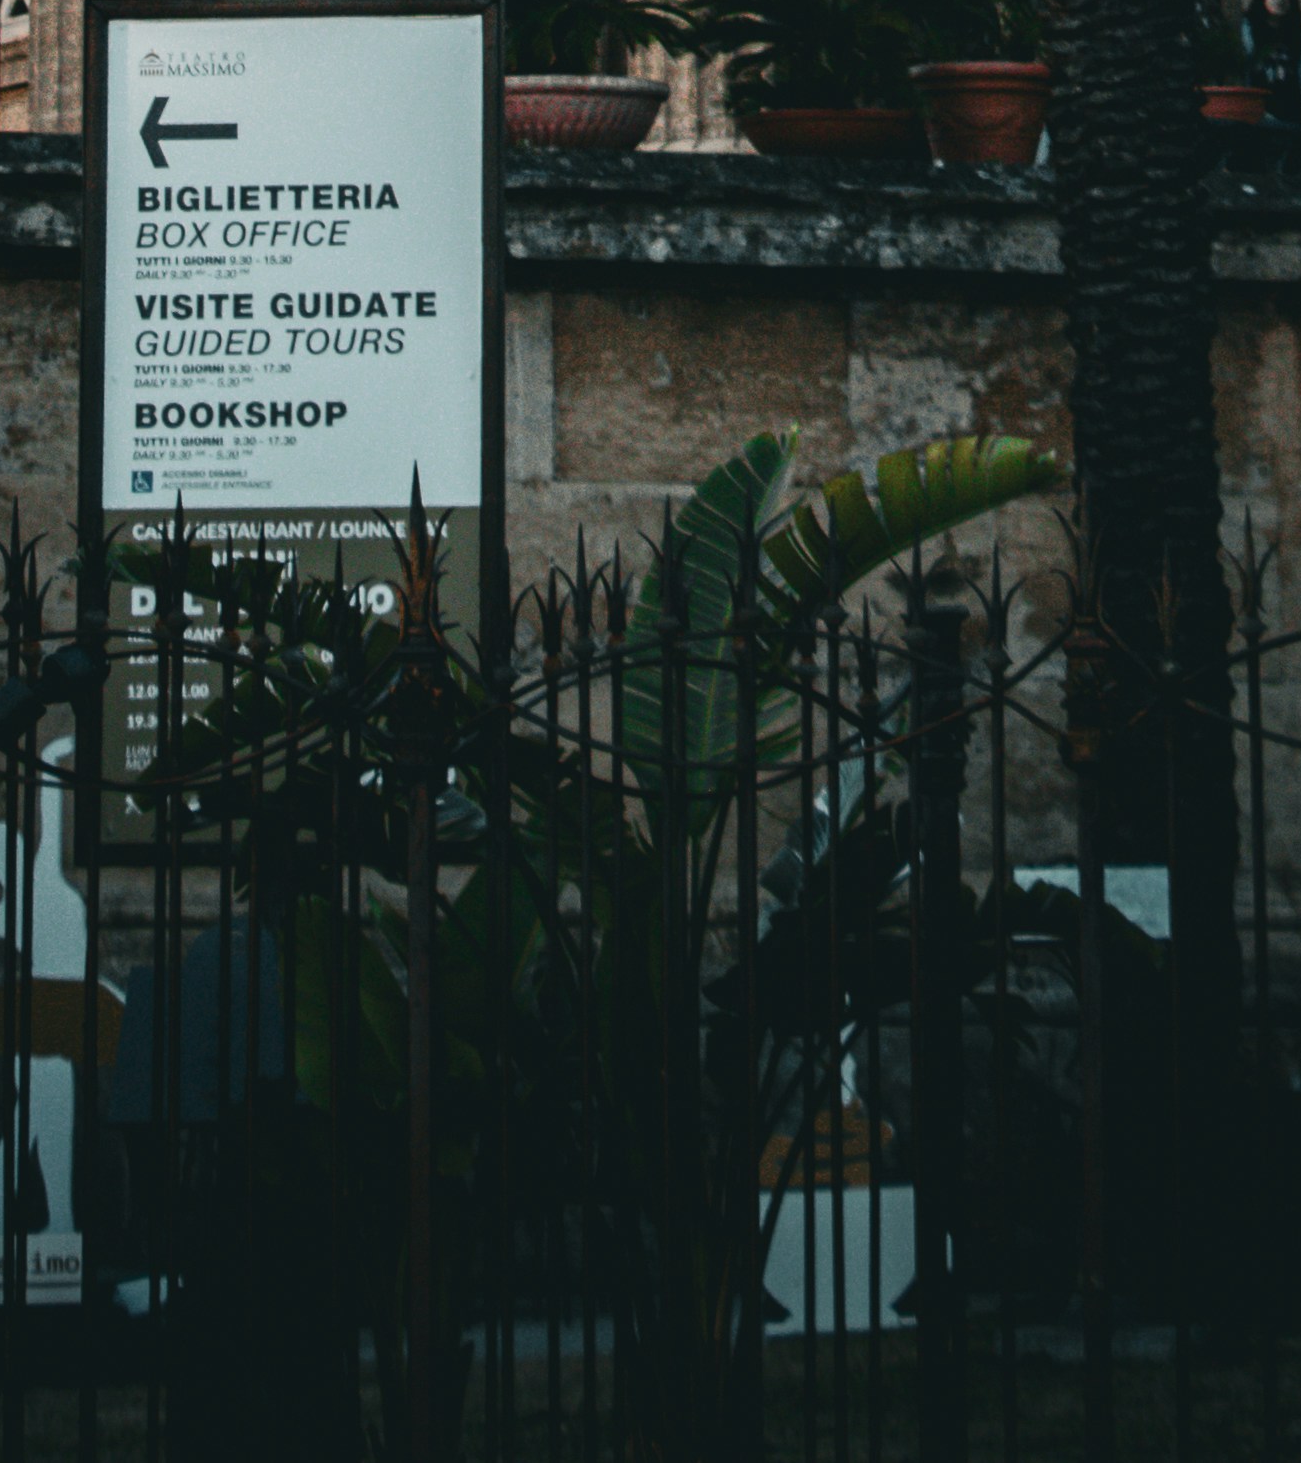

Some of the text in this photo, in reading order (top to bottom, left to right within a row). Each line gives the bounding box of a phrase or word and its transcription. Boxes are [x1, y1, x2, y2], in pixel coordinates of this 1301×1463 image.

[167, 51, 245, 62] TEATRO
[166, 62, 246, 76] MASSIMO
[137, 183, 400, 212] BIGLIETTERIA
[135, 219, 350, 249] BOX OFFICE
[136, 256, 171, 266] TUTTI
[183, 255, 226, 266] GIORNI
[135, 269, 167, 280] DAILY
[135, 292, 437, 320] VISITE GUIDATE
[135, 327, 406, 356] GUIDED TOURS
[134, 365, 170, 375] TUTTI
[182, 364, 225, 374] GIORNI
[134, 378, 166, 388] DAILY
[135, 401, 347, 428] BOOKSHOP
[133, 437, 169, 447] TUTTI
[181, 437, 224, 446] GIORNI
[132, 450, 165, 460] DAILY
[196, 521, 314, 540] RESTAURANT
